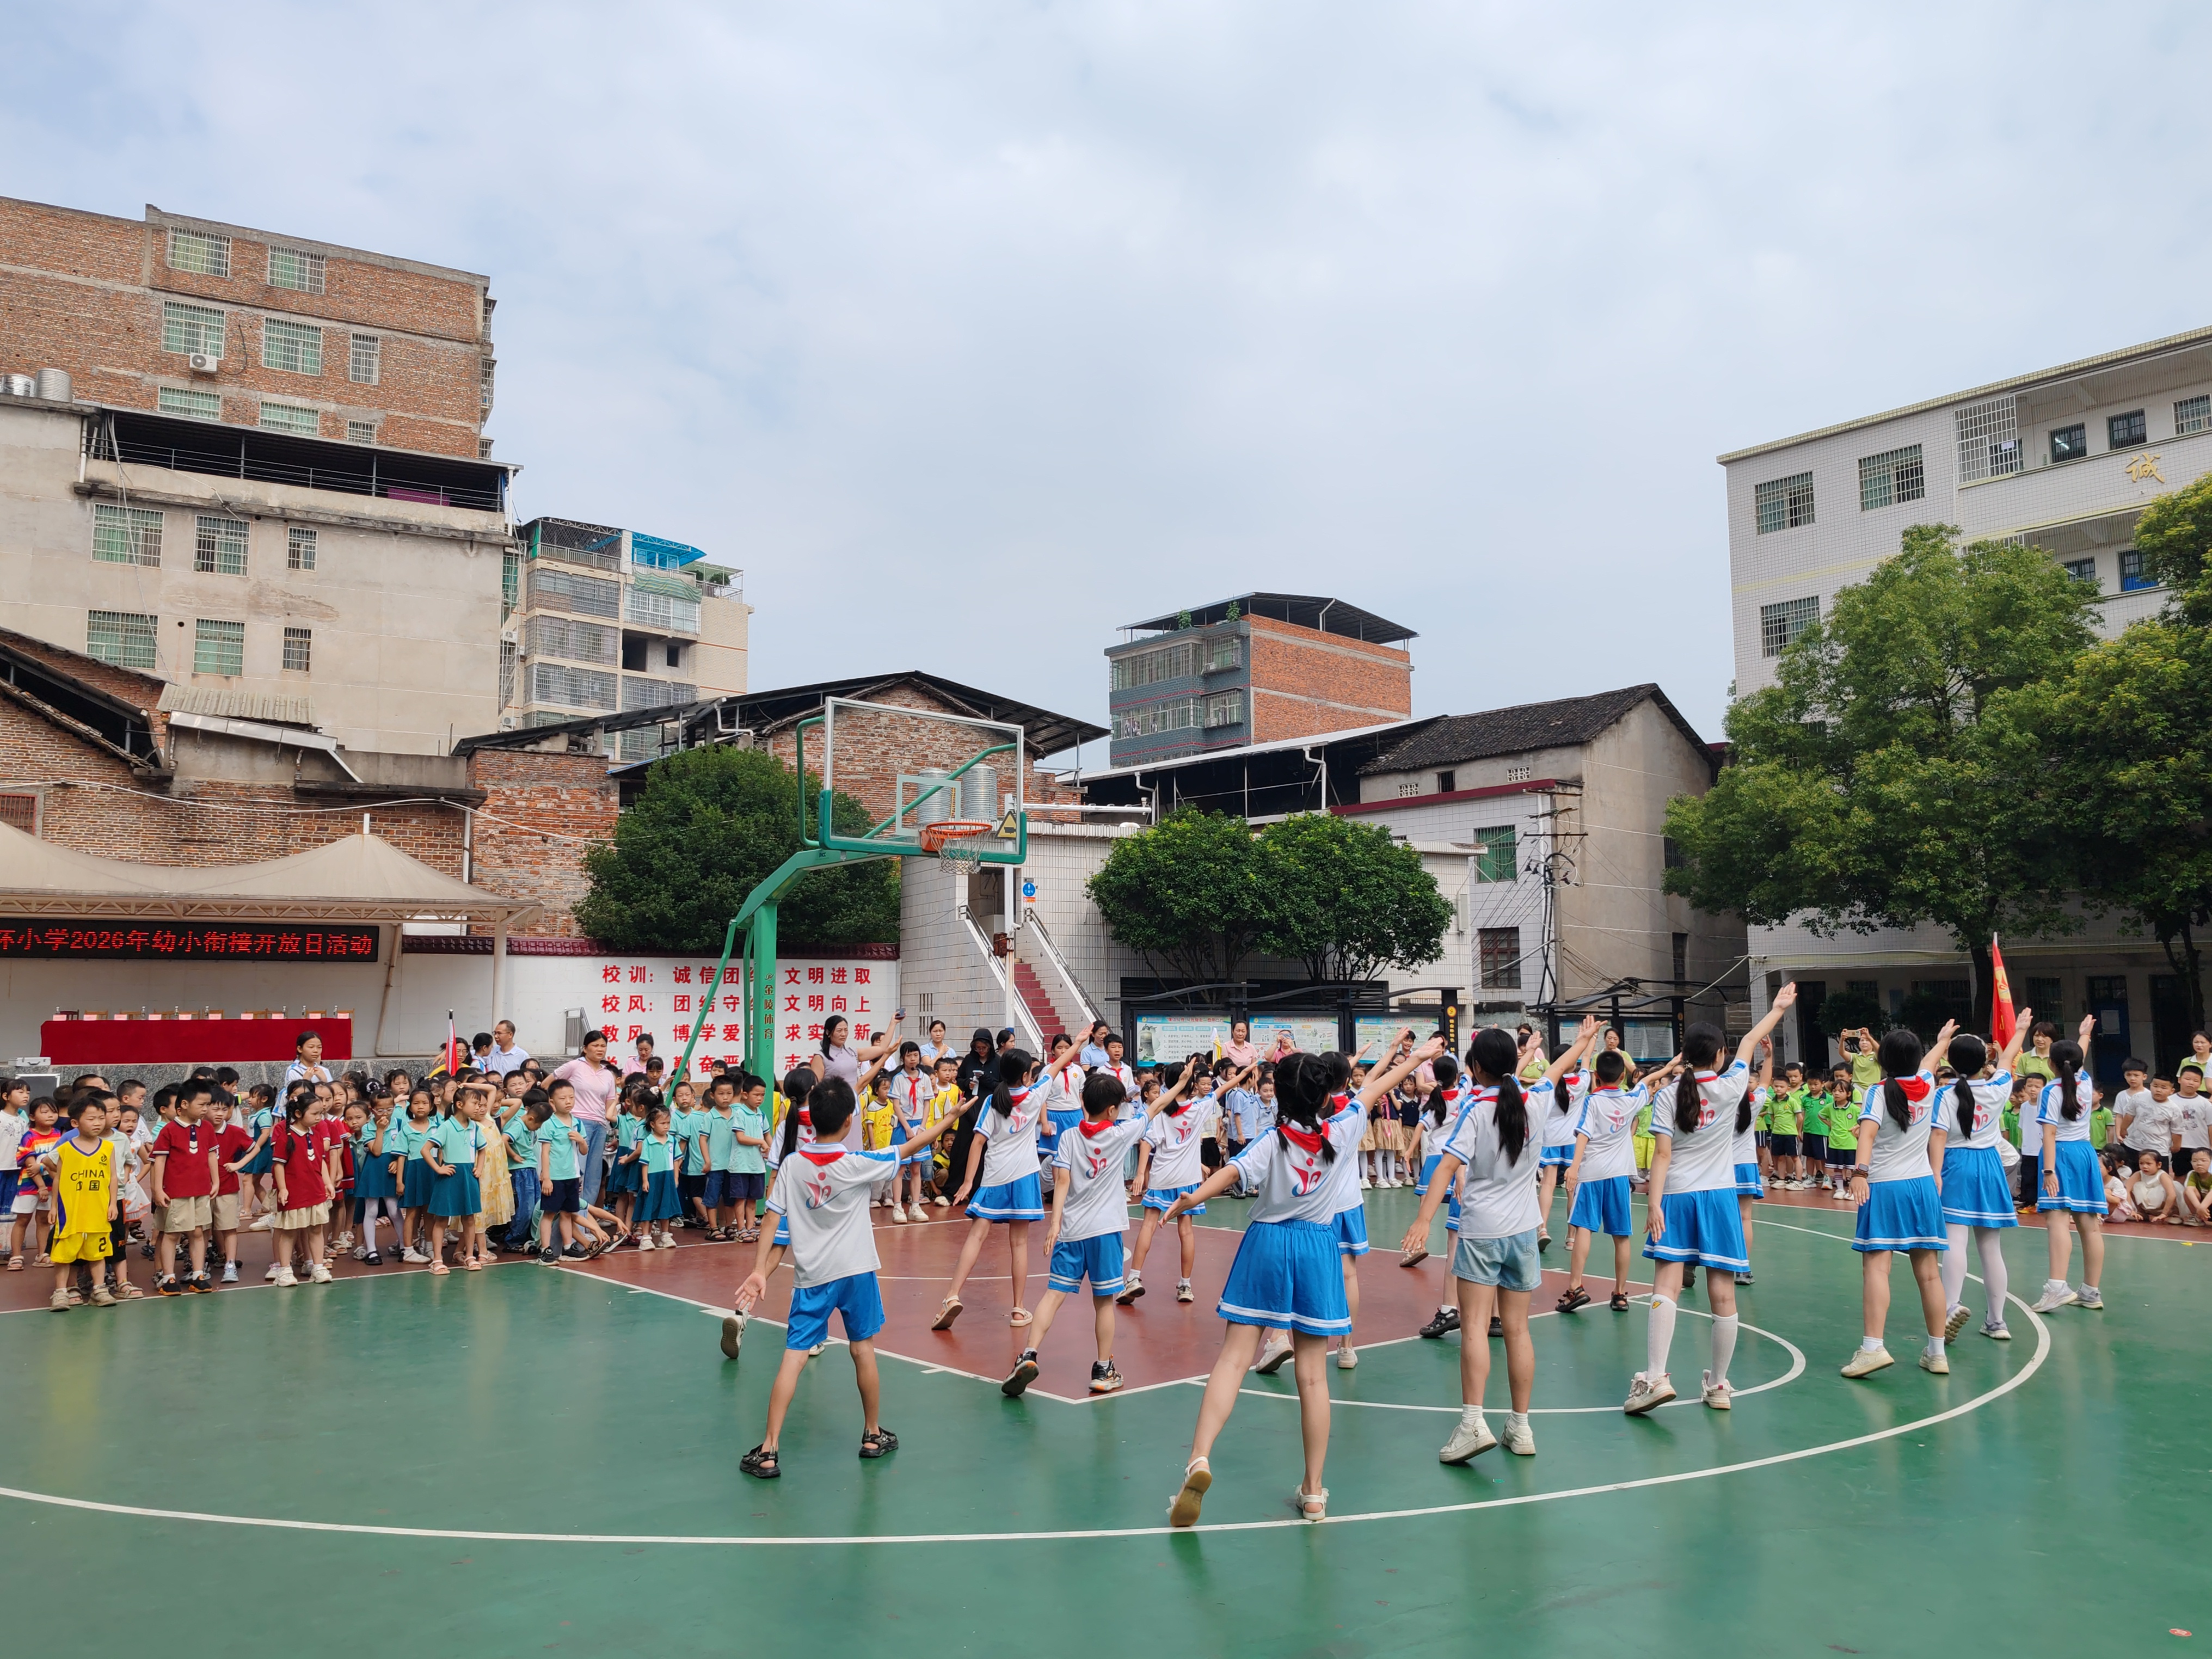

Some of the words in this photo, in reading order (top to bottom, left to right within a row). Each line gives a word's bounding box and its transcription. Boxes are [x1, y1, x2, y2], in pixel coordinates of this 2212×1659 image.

[2125, 453, 2165, 483] 诚
[602, 964, 653, 984] 校训：
[673, 966, 754, 985] 诚信团
[784, 967, 871, 985] 文明进取
[601, 994, 653, 1013] 校风：
[674, 994, 754, 1012] 团结守
[784, 994, 871, 1012] 文明向上
[764, 985, 774, 1040] 金陵体育
[673, 1023, 754, 1042] 博学爱
[785, 1023, 871, 1041] 求实新
[70, 1170, 105, 1181] CHINA
[99, 1237, 107, 1252] 2
